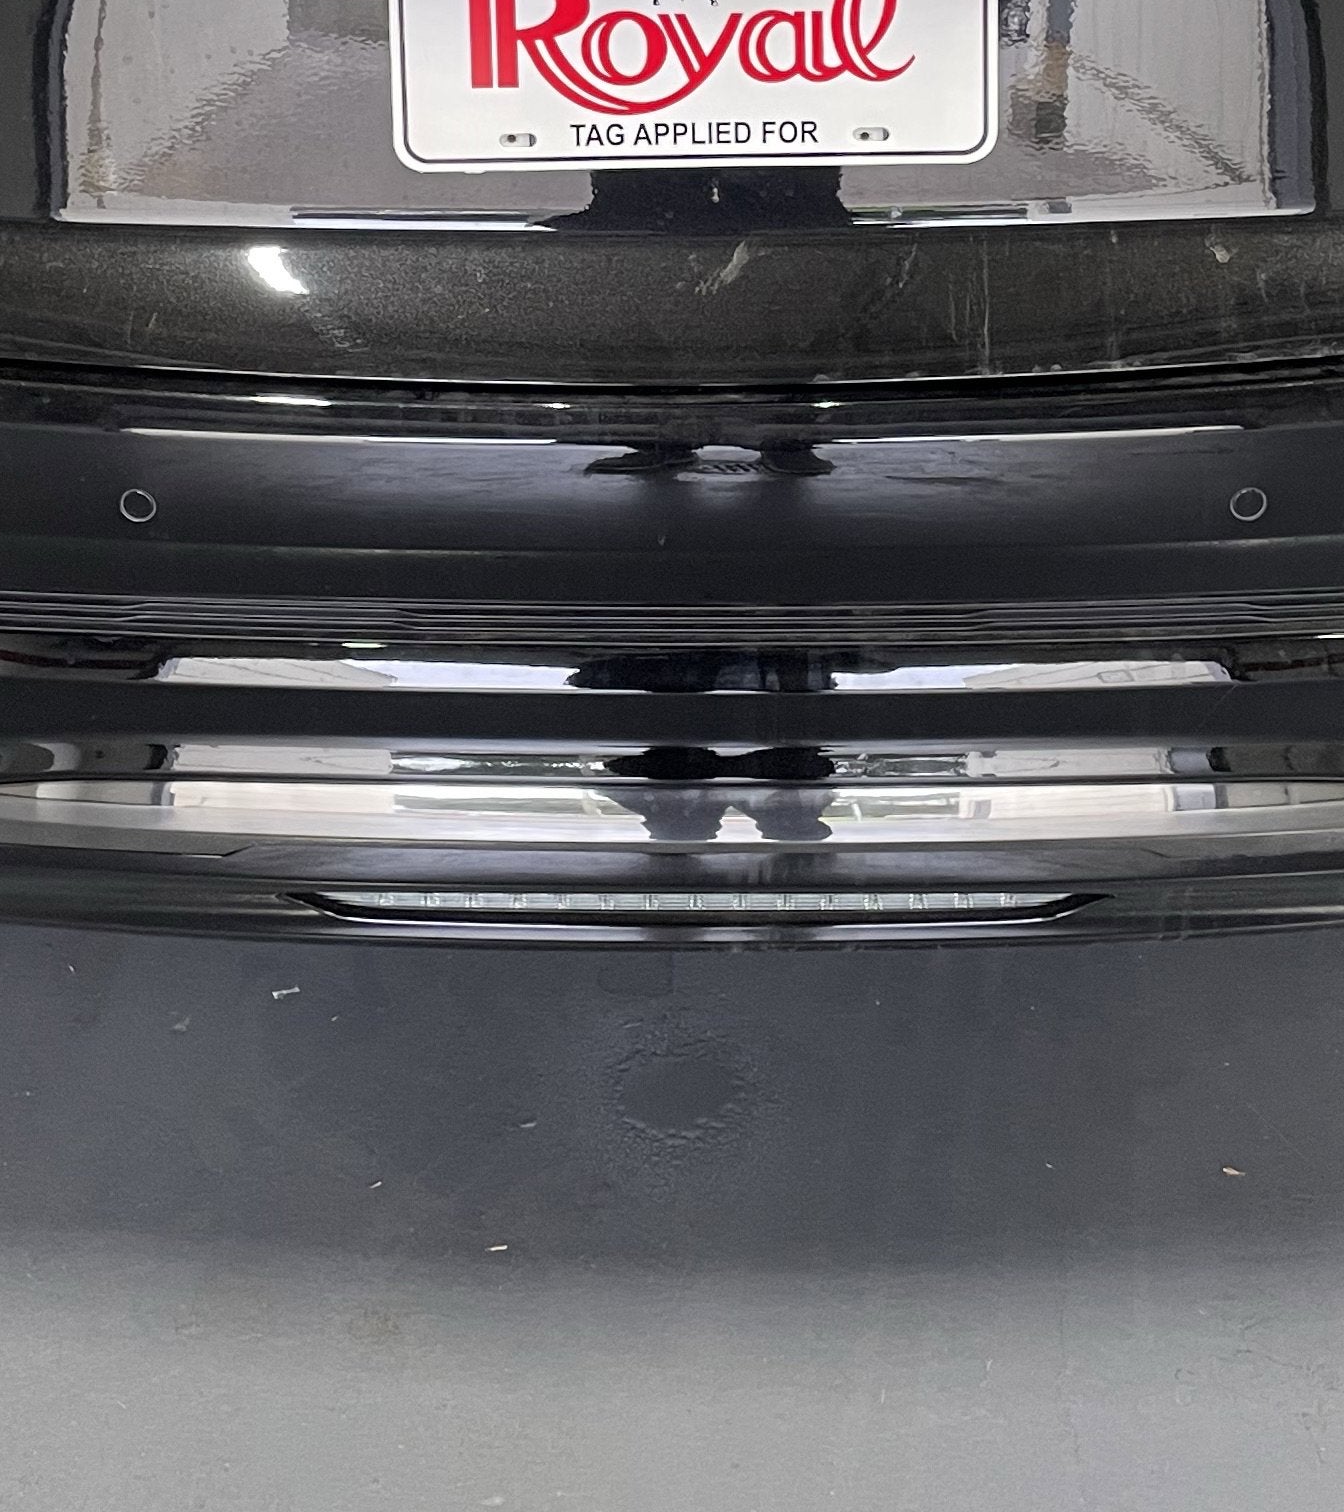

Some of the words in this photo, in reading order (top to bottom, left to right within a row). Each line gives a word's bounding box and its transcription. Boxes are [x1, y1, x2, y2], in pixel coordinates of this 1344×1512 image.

[570, 123, 625, 148] TAG
[634, 121, 753, 147] APPLIED
[761, 120, 819, 145] FOR
